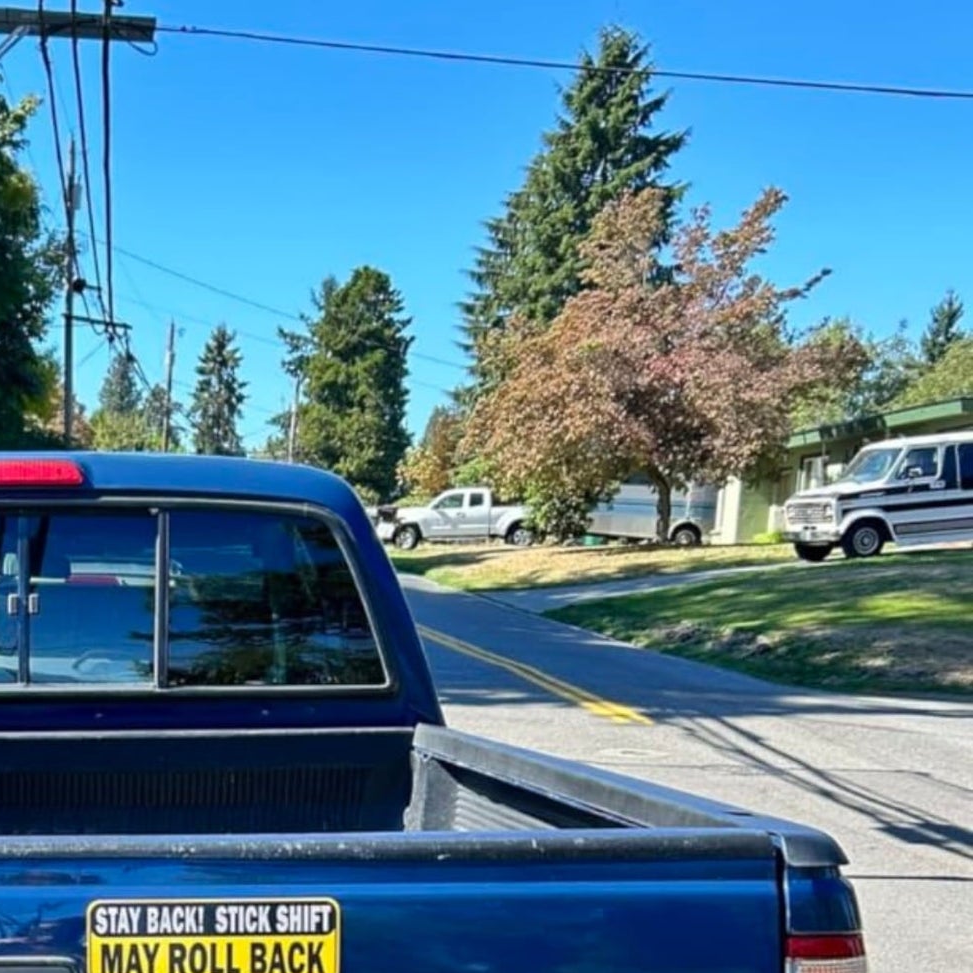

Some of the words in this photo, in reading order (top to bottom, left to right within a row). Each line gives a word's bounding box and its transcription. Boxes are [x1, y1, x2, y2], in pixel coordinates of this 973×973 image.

[94, 906, 142, 935] STAY
[146, 906, 204, 934] BACK!
[214, 905, 272, 934] STICK
[275, 904, 332, 933] SHIFT
